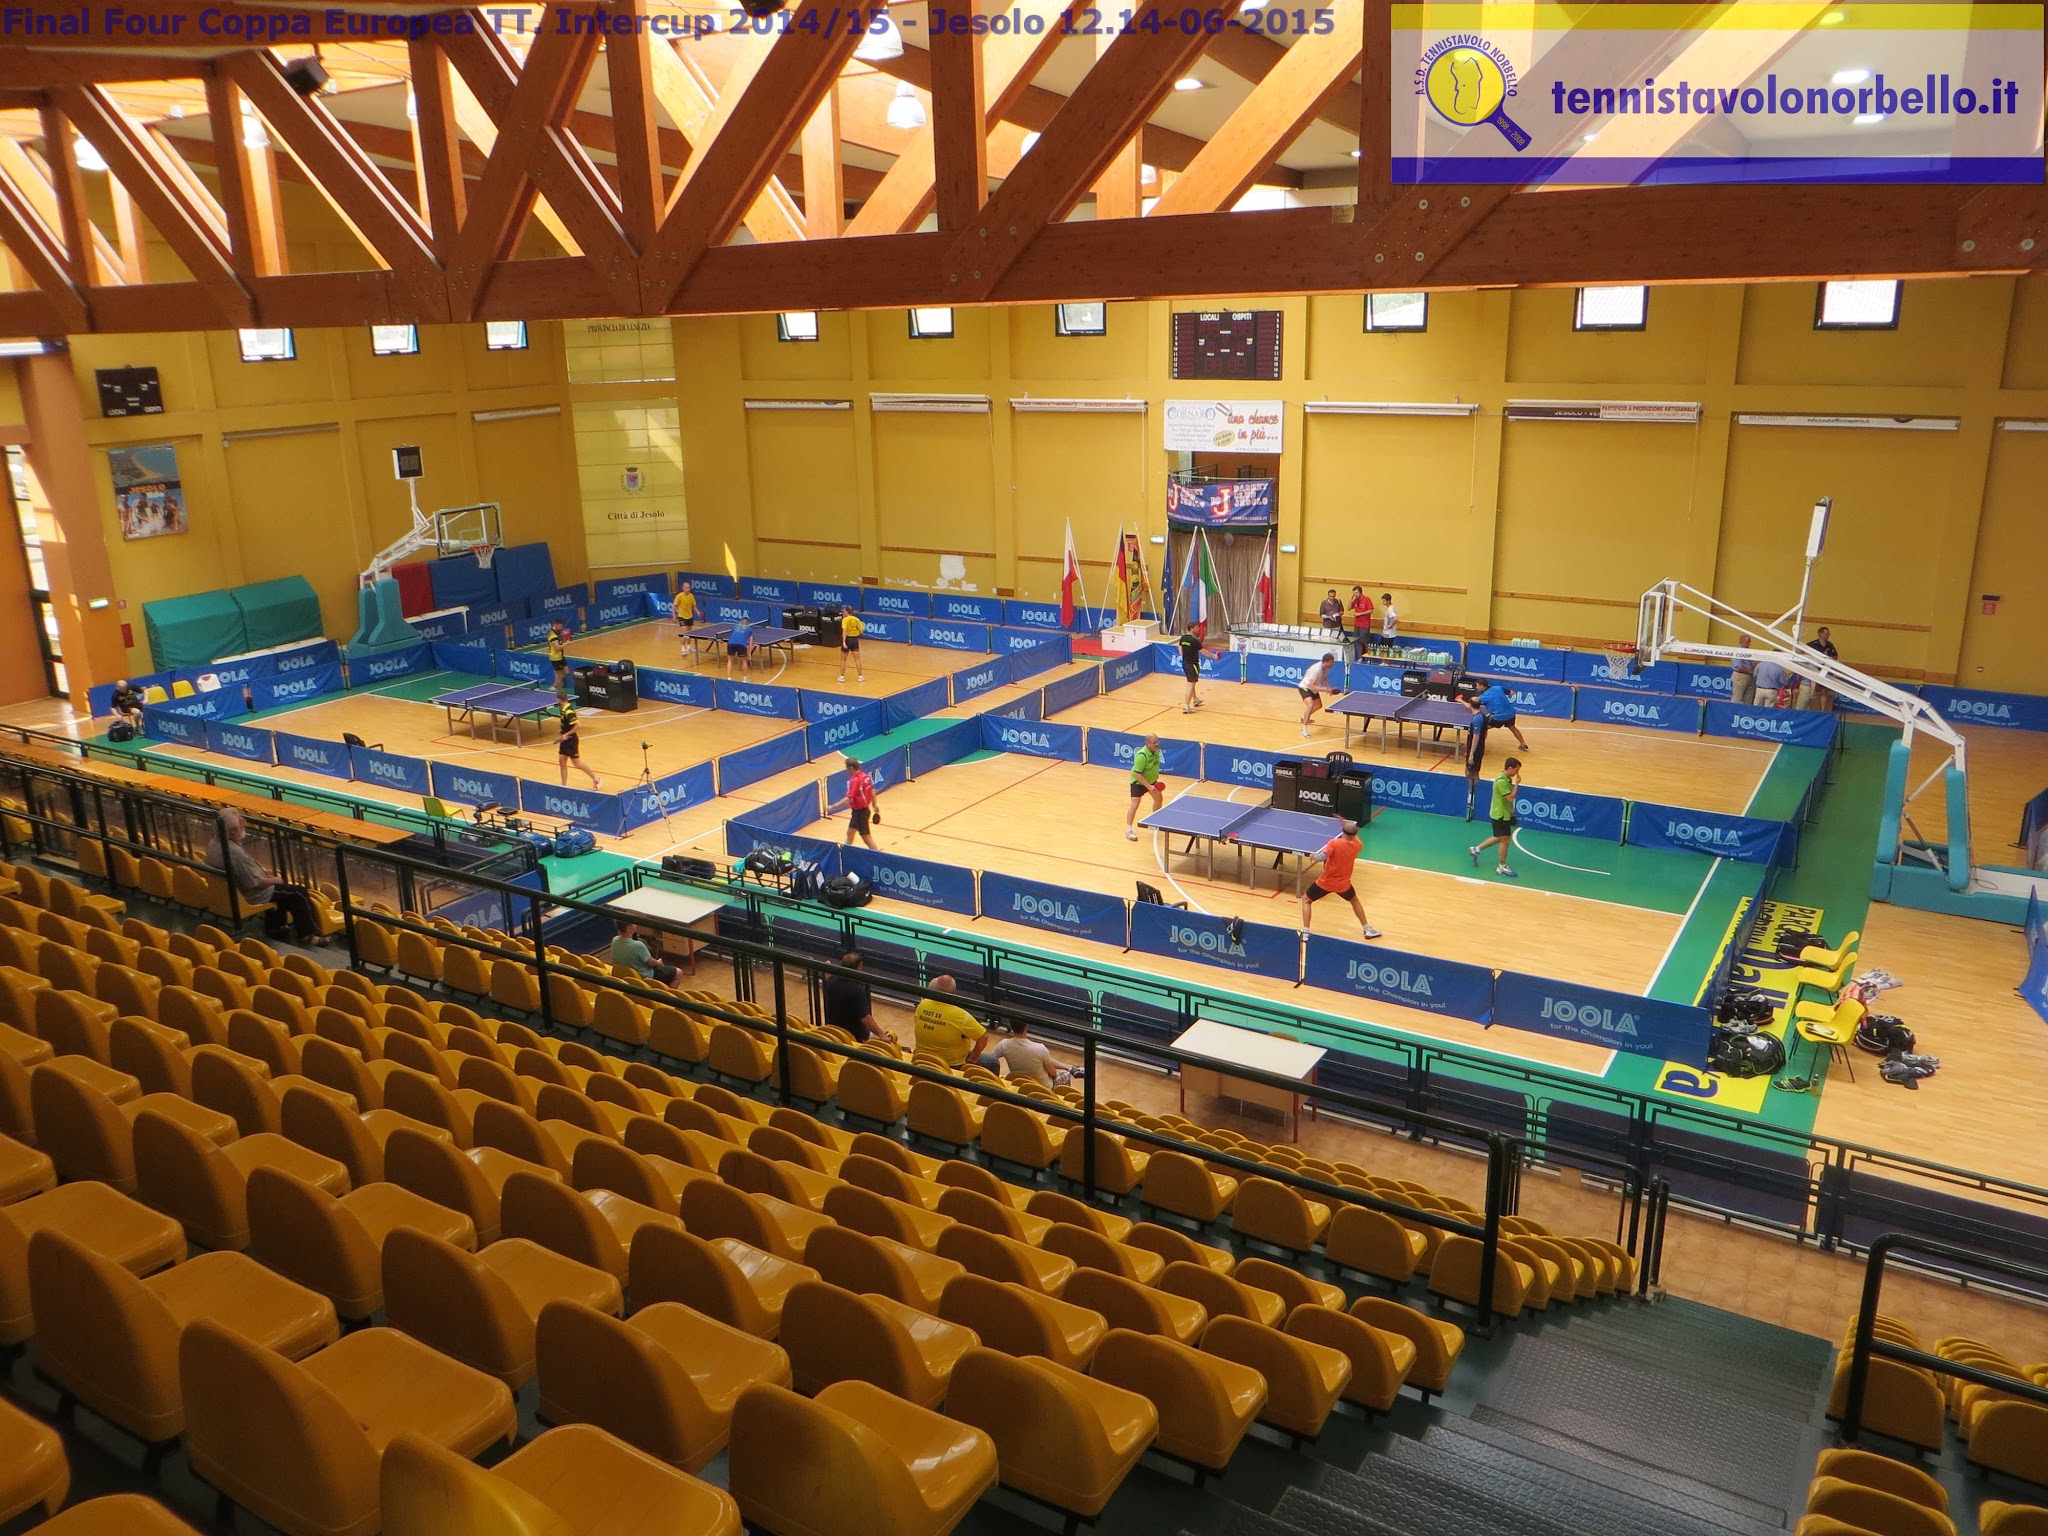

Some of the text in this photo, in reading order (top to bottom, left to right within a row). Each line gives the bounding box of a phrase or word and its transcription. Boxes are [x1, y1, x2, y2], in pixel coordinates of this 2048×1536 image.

[1167, 407, 1216, 420] CORNARO
[608, 510, 665, 521] Città di Jesolo
[613, 583, 647, 595] JOOLA
[753, 585, 780, 596] JOOLA
[814, 591, 842, 602] JOOLA
[879, 597, 909, 608] JOOLA
[948, 603, 981, 615] JOOLA
[600, 606, 628, 620] JOOLA
[720, 607, 750, 619] JOOLA
[1022, 610, 1056, 622] JOOLA
[417, 626, 444, 640] OOLA
[930, 629, 964, 642] JOOLA
[1010, 637, 1044, 649] JOOL
[1252, 640, 1294, 653] Città di Jesolo
[370, 658, 409, 675] JOOLA
[510, 661, 540, 675] JOOLA
[1490, 655, 1537, 670] JOOLA
[967, 670, 993, 690] JOOLA
[1268, 665, 1302, 679] JOOL
[273, 678, 317, 697] JOOLA
[655, 680, 690, 696] JOOLA
[1373, 676, 1401, 690] JOO
[1691, 675, 1732, 690] JOOL
[734, 691, 773, 707] JOOLA
[818, 702, 856, 715] JOOL
[1603, 701, 1659, 719] JOOLA
[1948, 699, 2010, 718] JOOLA
[825, 721, 859, 743] JOOLA
[1732, 715, 1792, 734] JOOLA
[222, 732, 254, 750] JOOLA
[1002, 728, 1049, 748] JOOLA
[294, 745, 329, 764] JOOLA
[370, 760, 406, 780] JOOLA
[1231, 758, 1273, 778] JOOL
[453, 777, 493, 798] JOOLA
[1372, 778, 1424, 800] OOLA
[641, 785, 686, 814] JOOLA
[1299, 790, 1329, 802] JOOLA
[545, 796, 591, 818] JOOLA
[1516, 799, 1575, 822] OOLA
[1666, 821, 1741, 846] JOOLA
[1696, 843, 1728, 855] Champion
[873, 866, 933, 893] JOOLA
[1013, 893, 1080, 924] JOOLA
[1170, 925, 1246, 957] JOOLA
[1202, 952, 1235, 966] Champion
[1347, 960, 1432, 996] JOOLA
[1382, 990, 1419, 1006] Champion
[1541, 997, 1638, 1036] JOOLA
[1581, 1029, 1622, 1046] Champion
